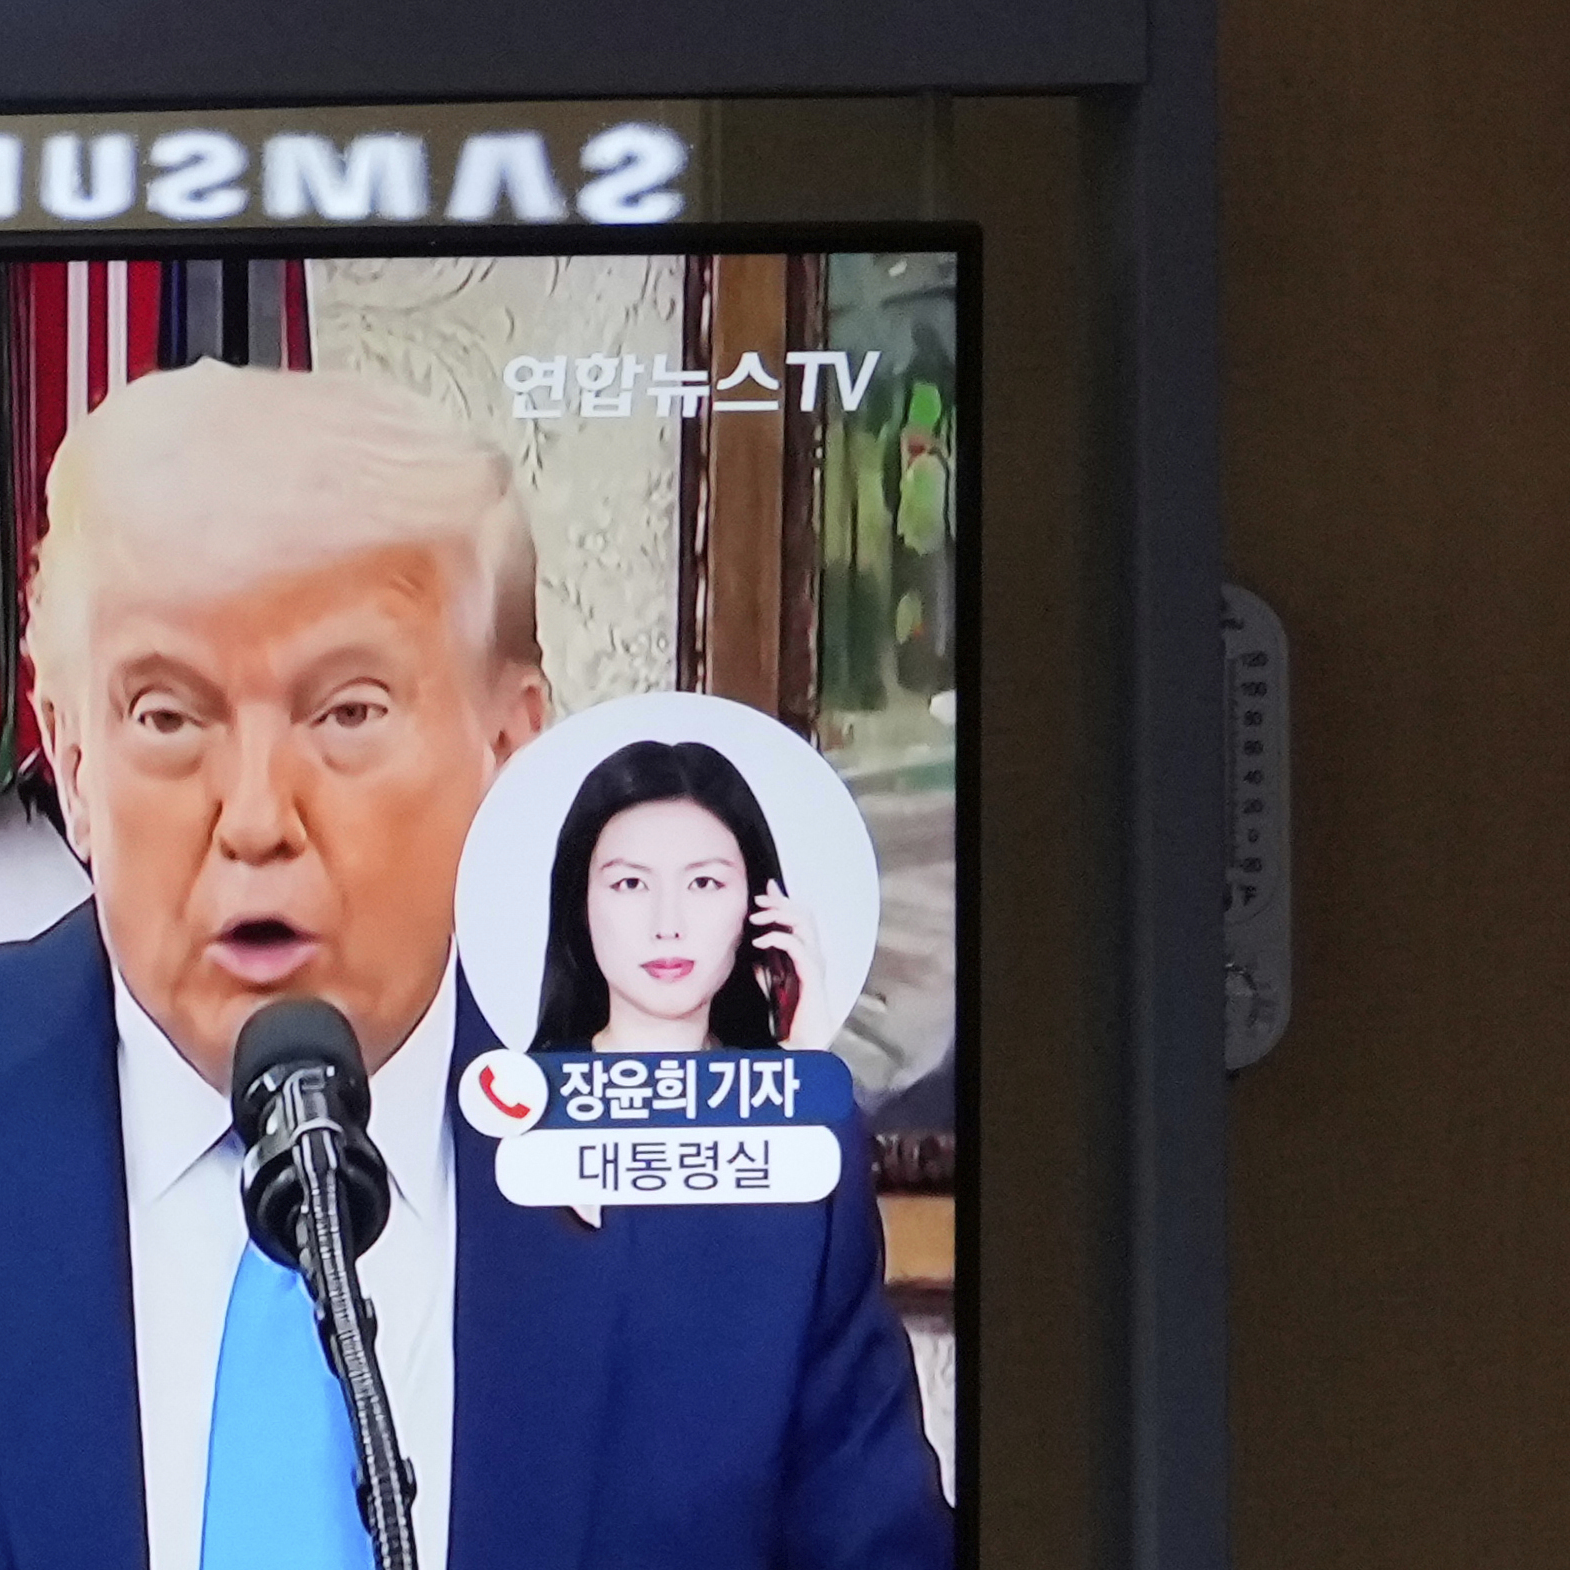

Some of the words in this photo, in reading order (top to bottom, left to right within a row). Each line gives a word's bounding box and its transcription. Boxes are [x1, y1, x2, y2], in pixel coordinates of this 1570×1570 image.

[502, 350, 881, 419] 연합뉴스TV
[559, 1059, 698, 1121] 장윤희
[707, 1058, 800, 1119] 기자
[578, 1139, 771, 1191] 대통령실
